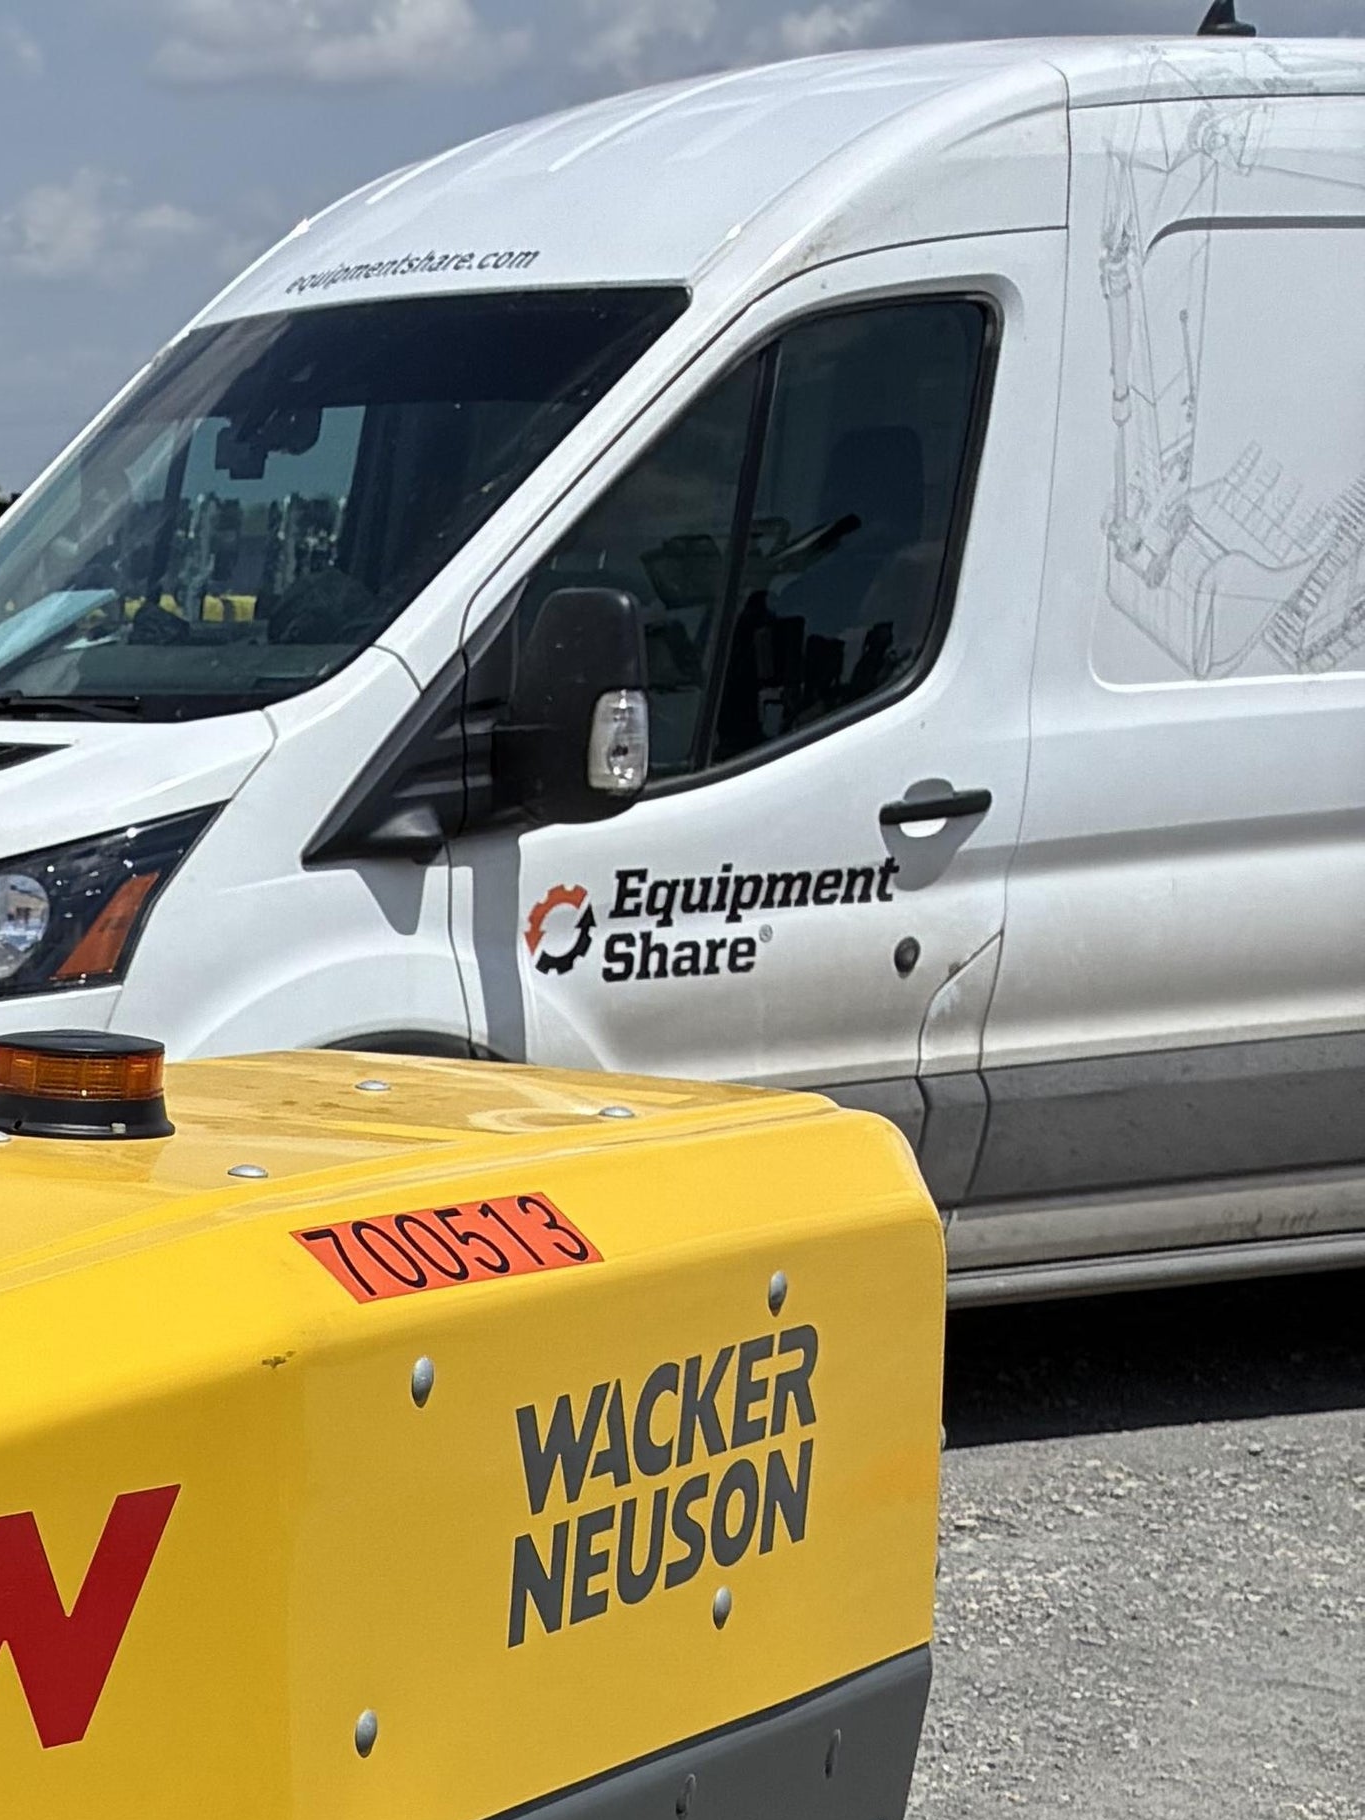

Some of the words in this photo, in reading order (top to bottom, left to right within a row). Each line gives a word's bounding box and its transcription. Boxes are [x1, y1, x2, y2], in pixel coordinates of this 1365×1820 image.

[285, 249, 541, 296] equipmentshare.com
[608, 856, 901, 928] Equipment
[302, 1193, 594, 1296] 700513
[514, 1323, 818, 1516] WACKER
[508, 1438, 815, 1649] NEUSON
